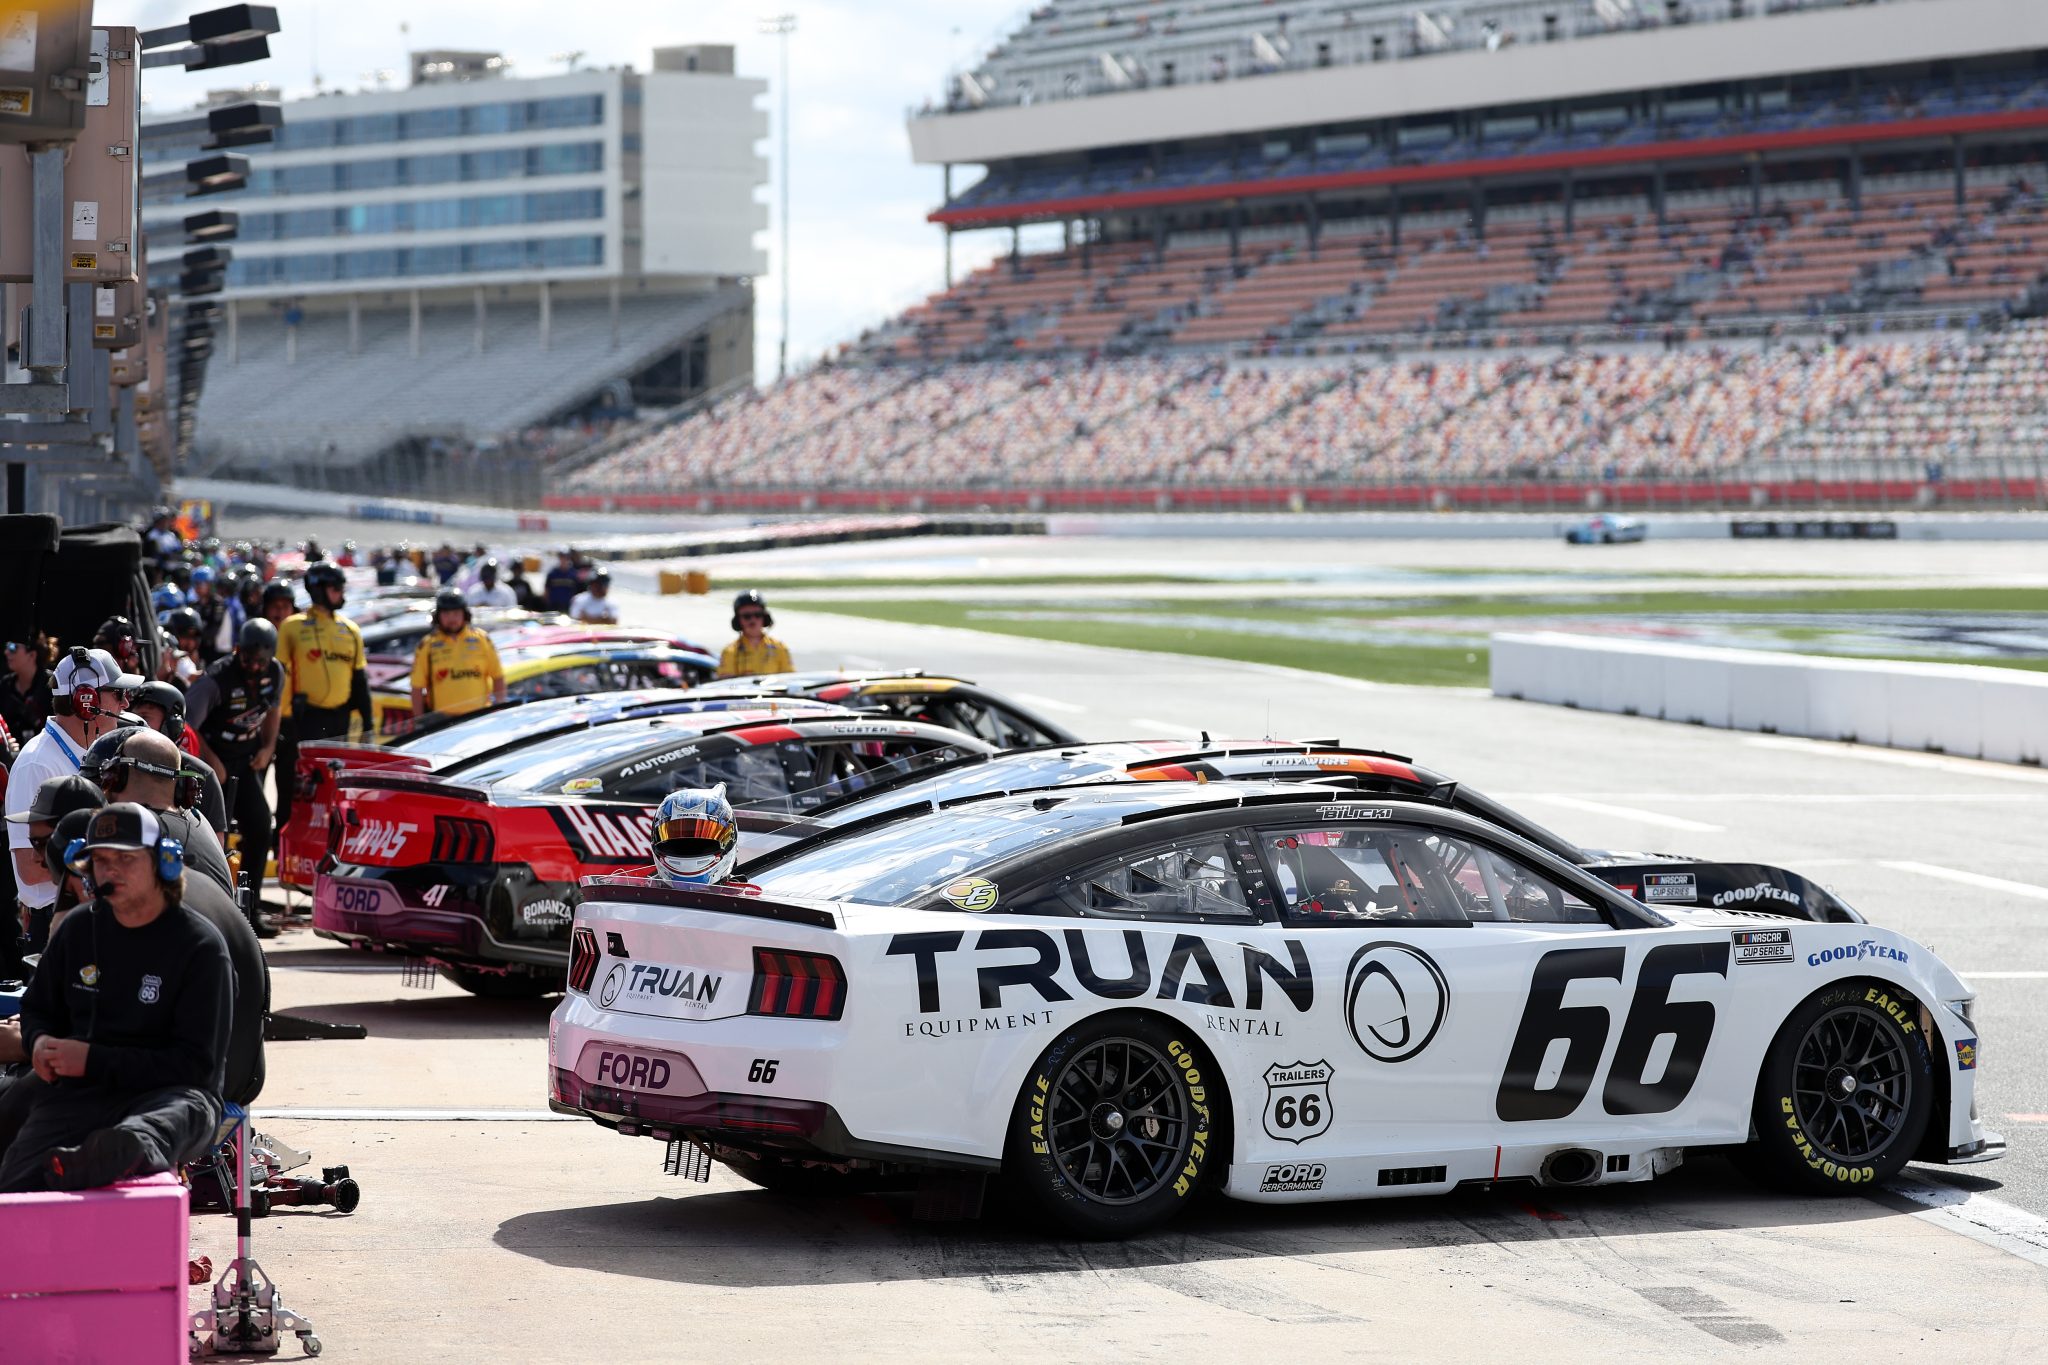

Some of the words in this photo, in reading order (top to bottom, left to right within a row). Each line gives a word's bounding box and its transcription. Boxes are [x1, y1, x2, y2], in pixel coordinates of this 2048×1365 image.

[633, 745, 699, 773] AUTODESK
[1303, 756, 1350, 767] WARE
[1322, 808, 1393, 820] BILICKI
[345, 818, 418, 859] HAAS
[1652, 887, 1666, 896] CUP
[1666, 887, 1690, 896] SERIES
[1661, 876, 1688, 884] NASCAR
[336, 887, 381, 912] FORD
[422, 884, 448, 907] 41
[523, 899, 573, 921] BONANZA
[1751, 932, 1782, 943] NASCAR
[1743, 947, 1758, 957] CUP
[1759, 946, 1785, 956] SERIES
[886, 929, 1315, 1014] TRUAN
[141, 986, 156, 1000] 66
[628, 964, 723, 1004] TRUAN
[626, 992, 653, 1001] EQUIPMENT
[685, 1001, 708, 1010] RENTAL
[1864, 987, 1917, 1034] EAGLE
[906, 1010, 1054, 1038] EQUIPMENT
[1206, 1014, 1284, 1037] RENTAL
[1496, 942, 1729, 1122] 66
[598, 1051, 671, 1090] FORD
[747, 1058, 780, 1084] 66
[1272, 1069, 1326, 1082] TRAILERS
[1031, 1074, 1050, 1155] EAGLE
[1275, 1093, 1321, 1129] 66
[1781, 1096, 1875, 1184] GOODYEAR
[1262, 1164, 1327, 1183] FORD
[1260, 1181, 1323, 1192] PERFORMANCE
